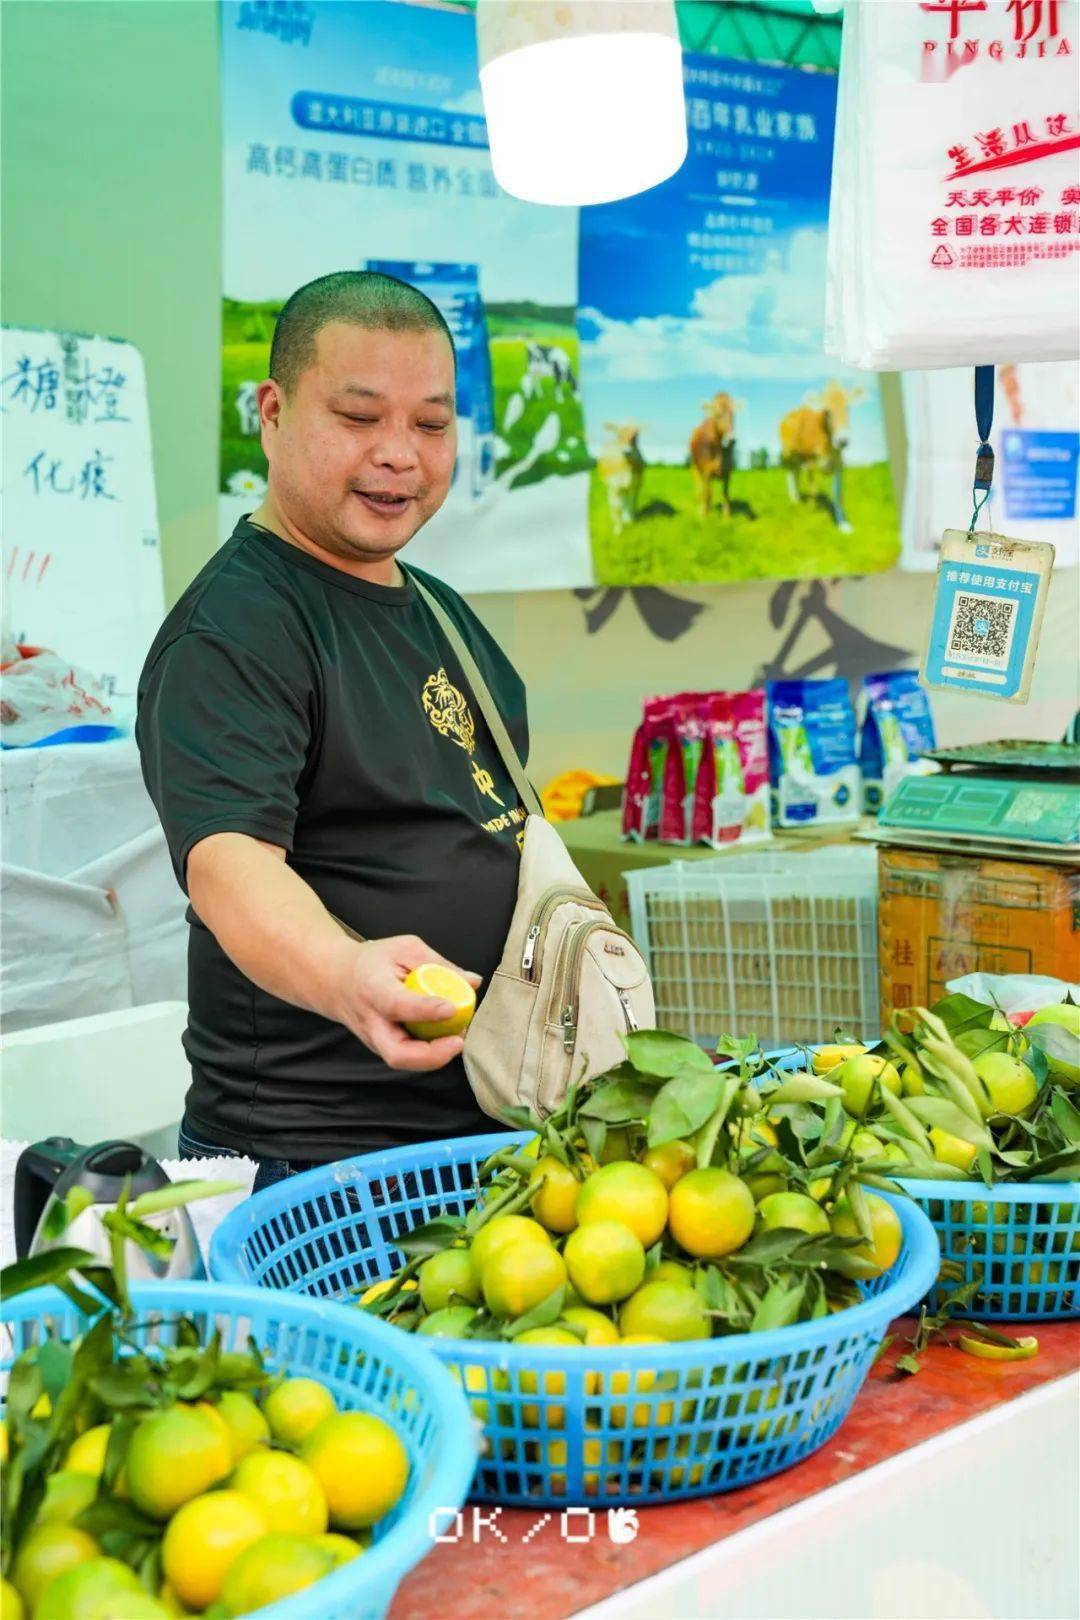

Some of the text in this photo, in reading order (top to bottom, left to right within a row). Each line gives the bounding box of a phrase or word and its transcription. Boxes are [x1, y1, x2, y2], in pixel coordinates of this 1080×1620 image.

[687, 97, 817, 143] 百年乳业家族
[944, 187, 1041, 208] 天天平价
[930, 214, 1080, 237] 全国各大连锁
[945, 569, 1033, 595] 推荐使用支付宝
